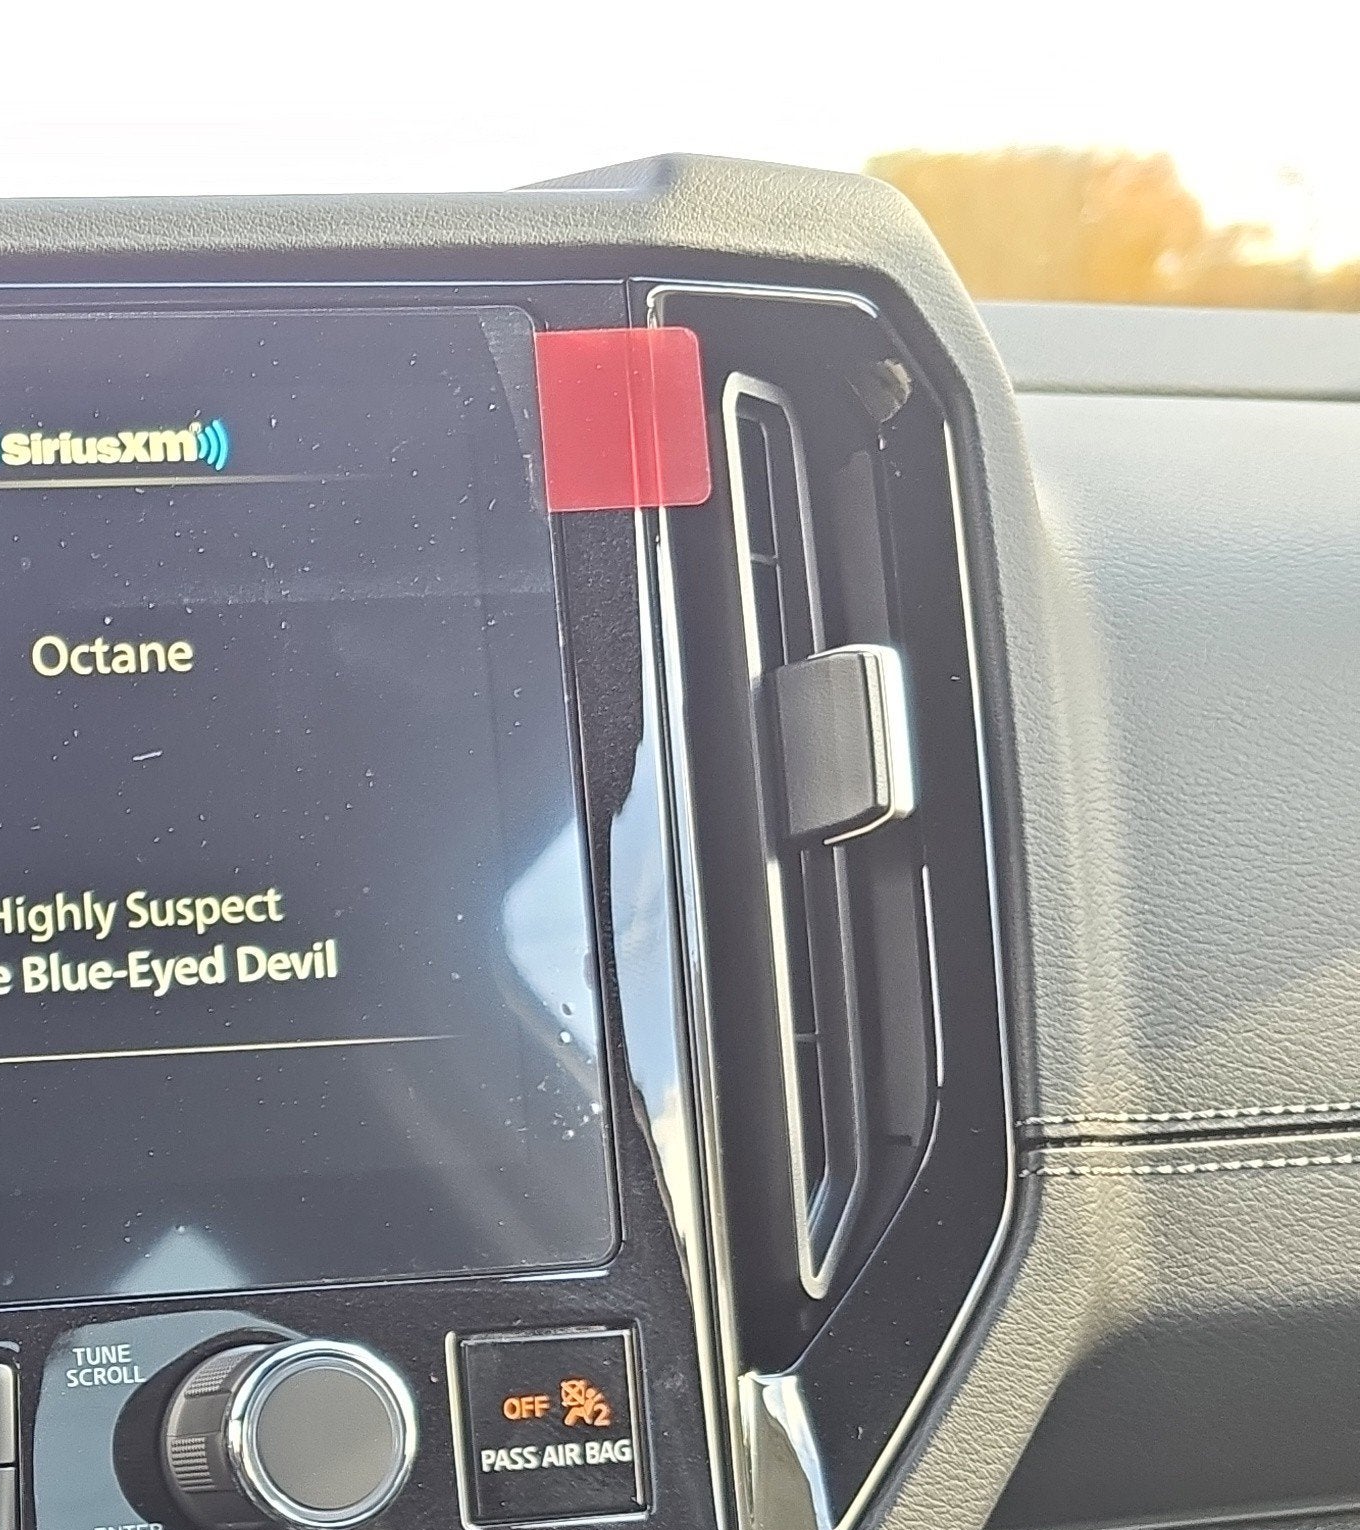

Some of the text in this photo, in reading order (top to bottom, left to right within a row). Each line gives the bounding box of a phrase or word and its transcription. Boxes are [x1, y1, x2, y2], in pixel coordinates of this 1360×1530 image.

[32, 634, 194, 677] Octane
[127, 887, 284, 935] Suspect
[22, 945, 225, 996] Blue-Eyed
[237, 939, 338, 985] Devil
[73, 1345, 130, 1366] TUNE
[67, 1363, 145, 1387] SCROLL
[503, 1395, 550, 1420] OFF
[481, 1438, 632, 1473] PASS AIR BAG
